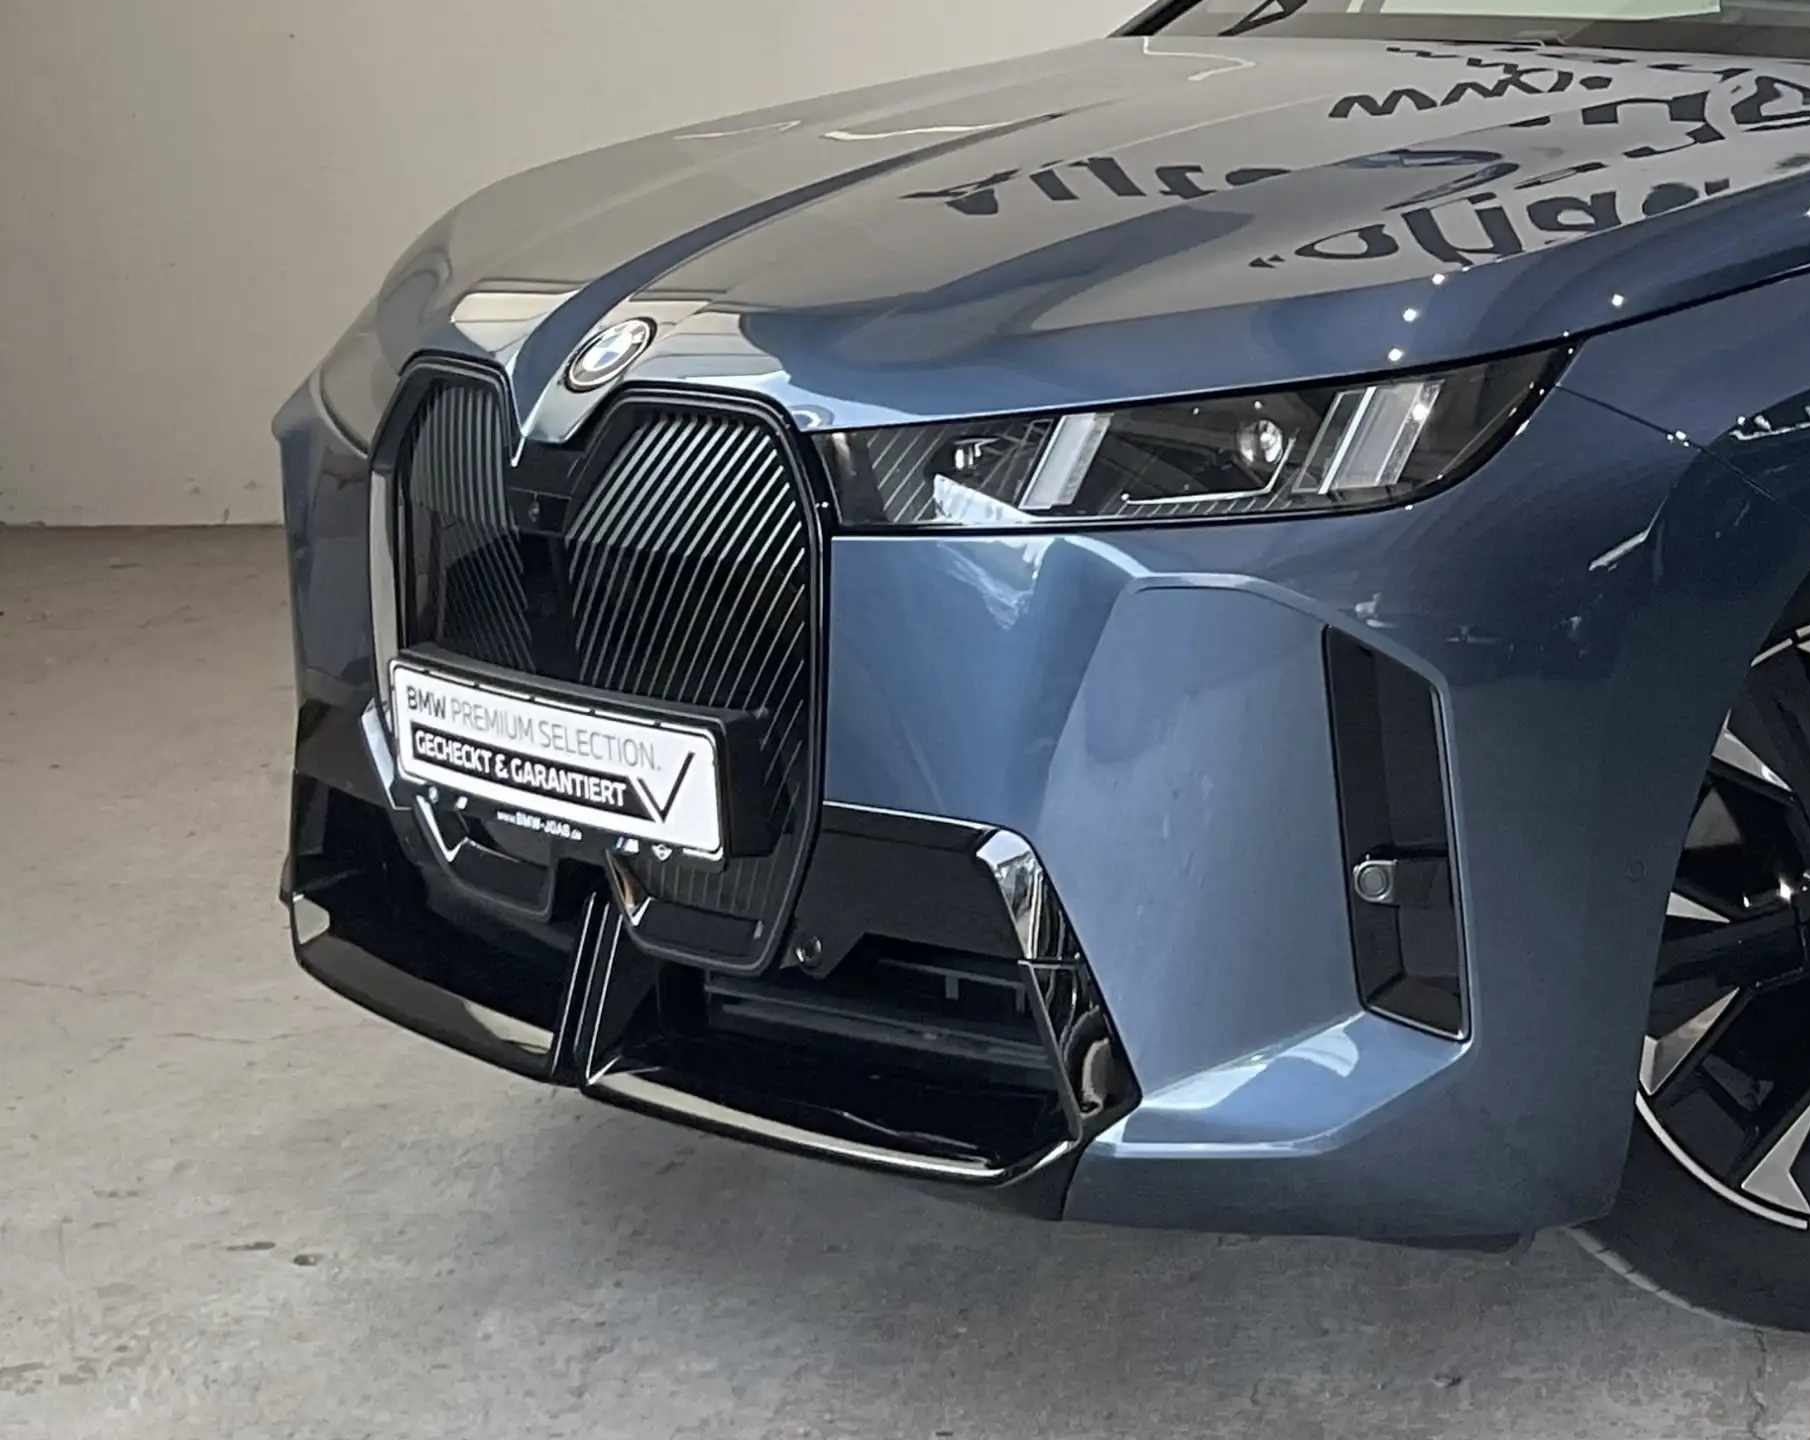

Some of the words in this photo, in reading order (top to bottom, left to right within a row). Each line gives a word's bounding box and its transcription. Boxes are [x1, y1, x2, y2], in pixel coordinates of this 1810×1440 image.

[406, 685, 448, 719] BMW
[451, 697, 535, 744] PREMIUM
[540, 720, 662, 771] SELECTION.
[415, 729, 493, 775] GECHECKT
[495, 753, 510, 779] &
[510, 759, 627, 808] GARANTIERT
